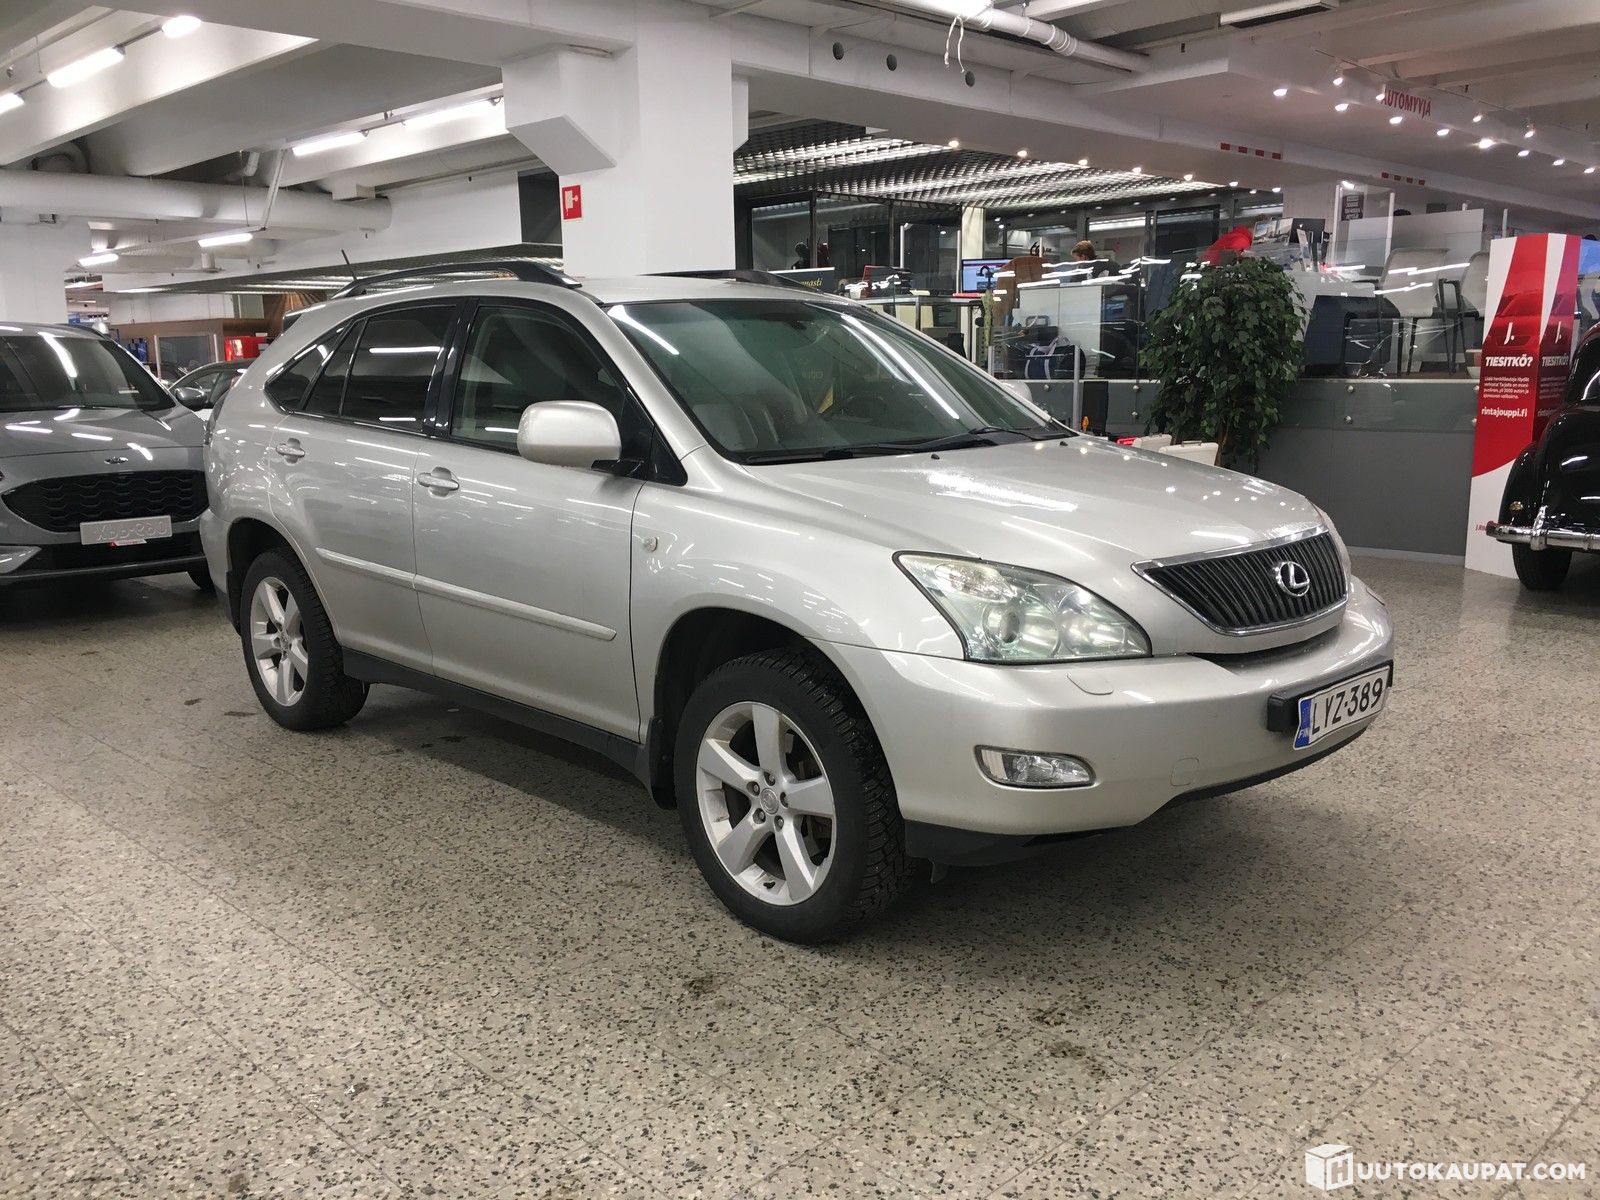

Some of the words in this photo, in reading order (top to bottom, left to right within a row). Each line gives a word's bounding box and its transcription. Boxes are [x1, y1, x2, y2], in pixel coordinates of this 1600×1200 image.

[1381, 89, 1432, 119] AUTOMYYJÄ
[1485, 354, 1534, 367] TIESITKÖ?
[1481, 407, 1528, 419] rintajouppi.fi
[1311, 677, 1384, 735] LYZ-389
